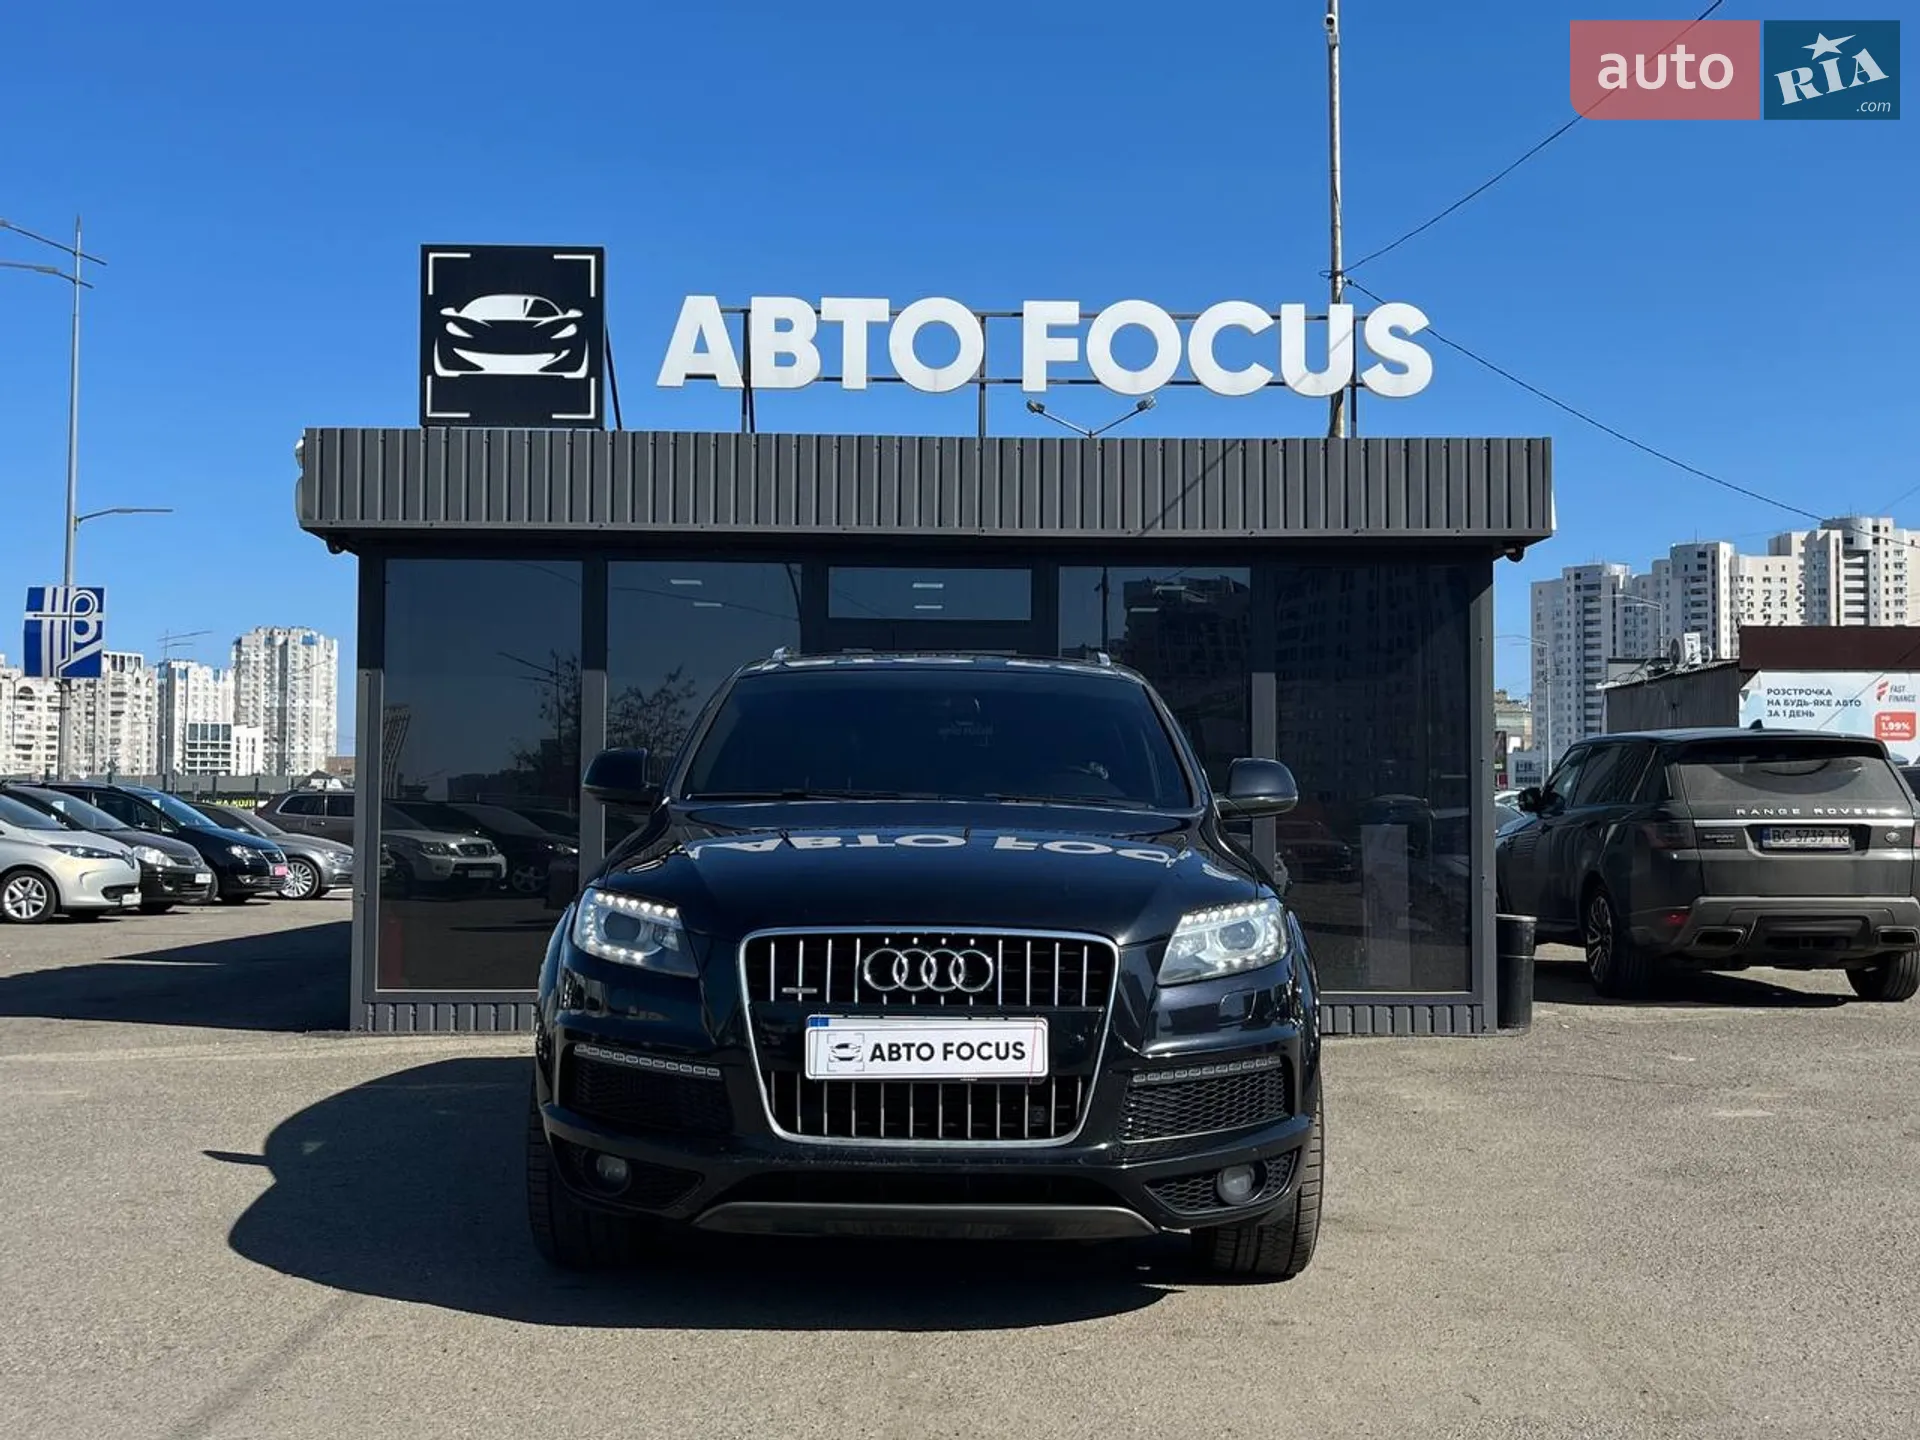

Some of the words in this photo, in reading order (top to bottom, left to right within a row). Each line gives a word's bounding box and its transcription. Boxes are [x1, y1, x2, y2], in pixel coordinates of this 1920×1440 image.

[656, 295, 984, 392] АВТО
[1022, 299, 1433, 398] FOCUS
[1766, 687, 1832, 697] РОЗСТРОЧКА
[1890, 684, 1906, 693] FAST
[1766, 699, 1782, 707] НА
[1783, 699, 1834, 708] БУДЬ-ЯКЕ
[1835, 699, 1862, 708] АВТО
[1767, 709, 1781, 718] ЗА
[1788, 709, 1815, 719] ДЕНЬ
[1735, 808, 1801, 816] RANGE
[1813, 807, 1878, 816] ROVER
[1772, 829, 1793, 842] BC
[1795, 829, 1825, 842] 5739
[1828, 829, 1849, 842] TK
[869, 1042, 935, 1062] АВТО
[942, 1041, 1026, 1061] FOCUS
